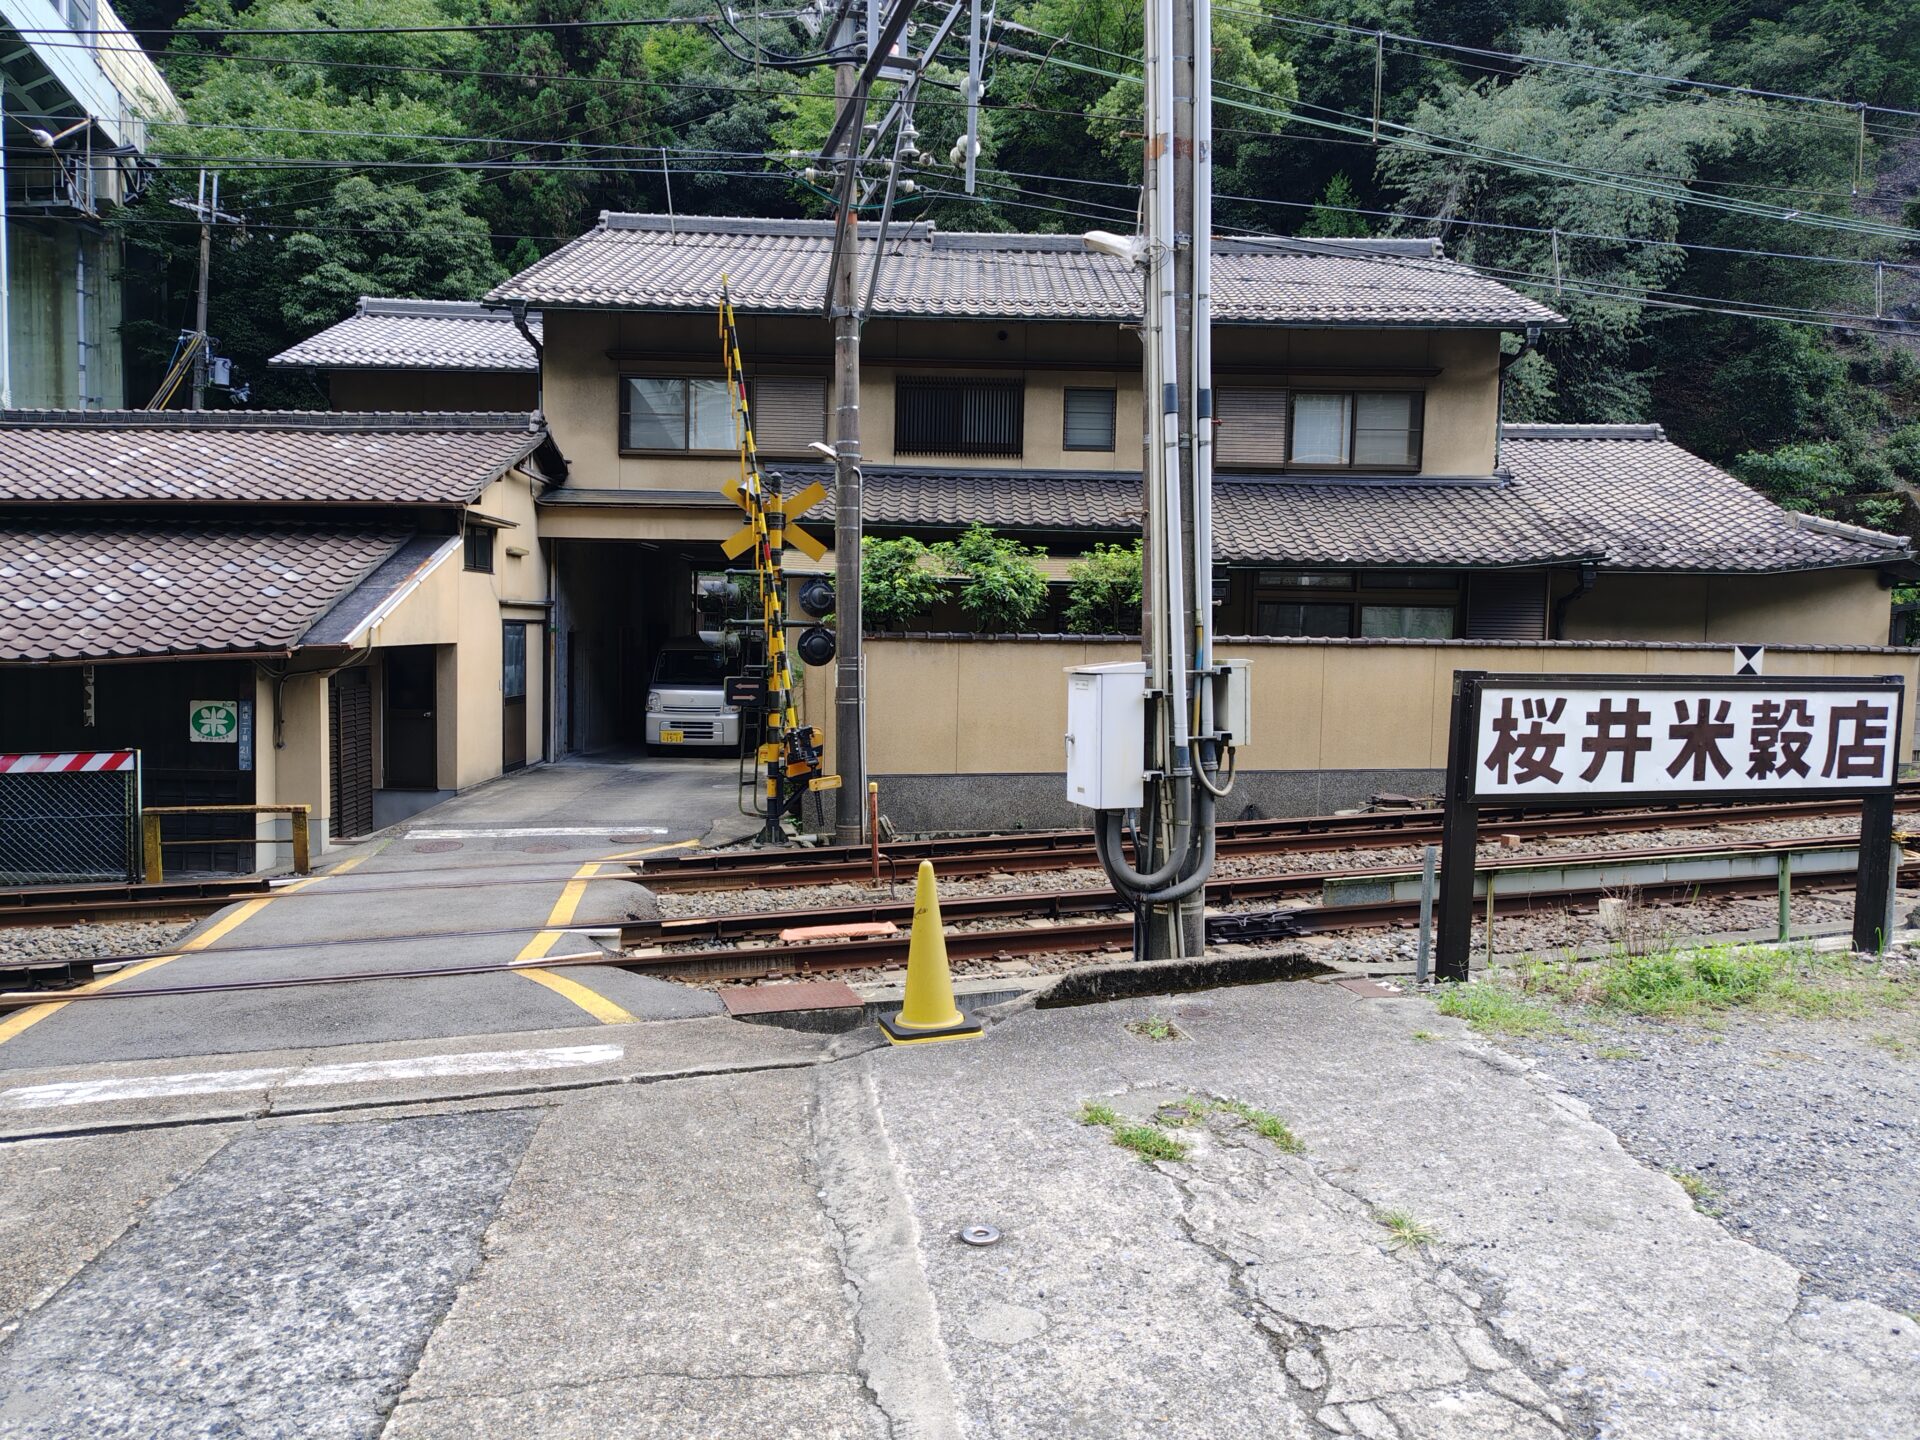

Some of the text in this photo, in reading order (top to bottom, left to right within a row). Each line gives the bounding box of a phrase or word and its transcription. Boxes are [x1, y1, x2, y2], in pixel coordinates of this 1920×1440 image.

[1484, 697, 1888, 785] 桜井米穀店
